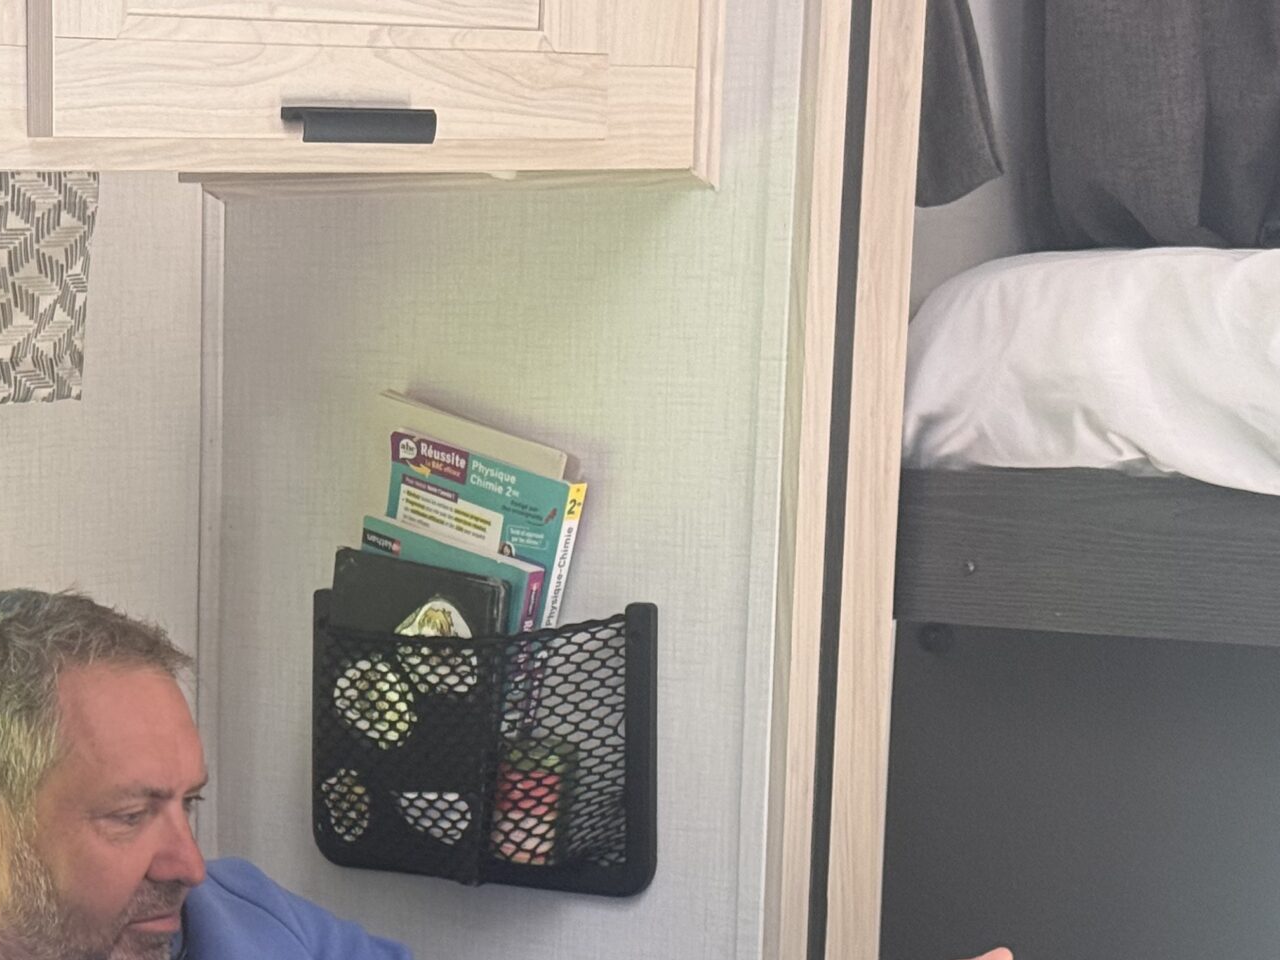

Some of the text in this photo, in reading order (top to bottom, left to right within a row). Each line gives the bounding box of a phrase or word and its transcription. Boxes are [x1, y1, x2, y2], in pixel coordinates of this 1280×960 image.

[420, 442, 466, 469] Réussite
[470, 474, 503, 495] Chimie
[472, 460, 516, 484] Physique
[545, 526, 574, 627] Physique-Chimie
